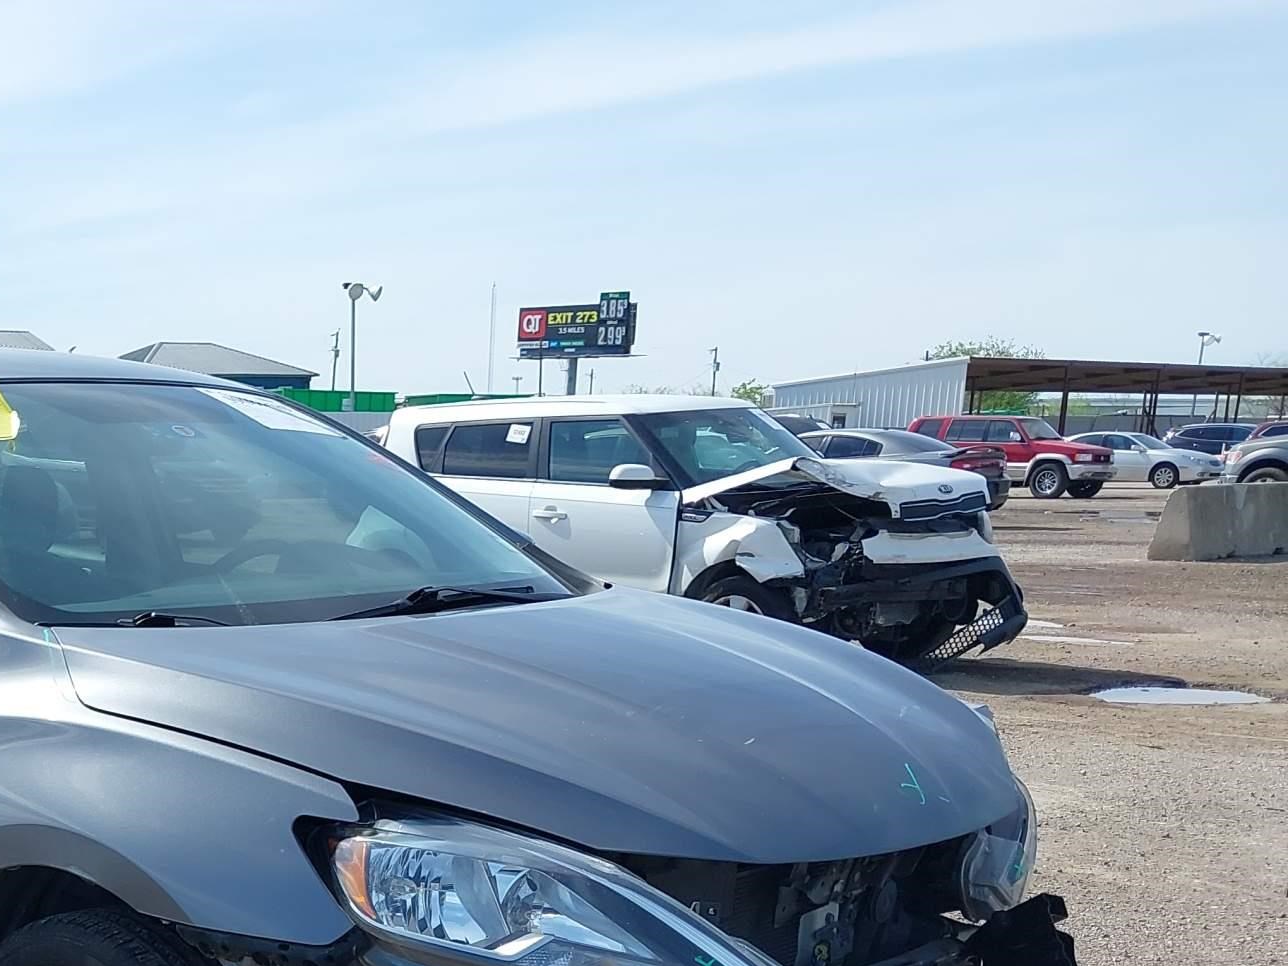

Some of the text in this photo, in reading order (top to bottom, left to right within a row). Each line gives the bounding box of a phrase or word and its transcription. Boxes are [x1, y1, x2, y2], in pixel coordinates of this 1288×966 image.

[523, 314, 542, 334] QT
[547, 310, 598, 325] EXIT 273
[568, 326, 585, 334] MILES
